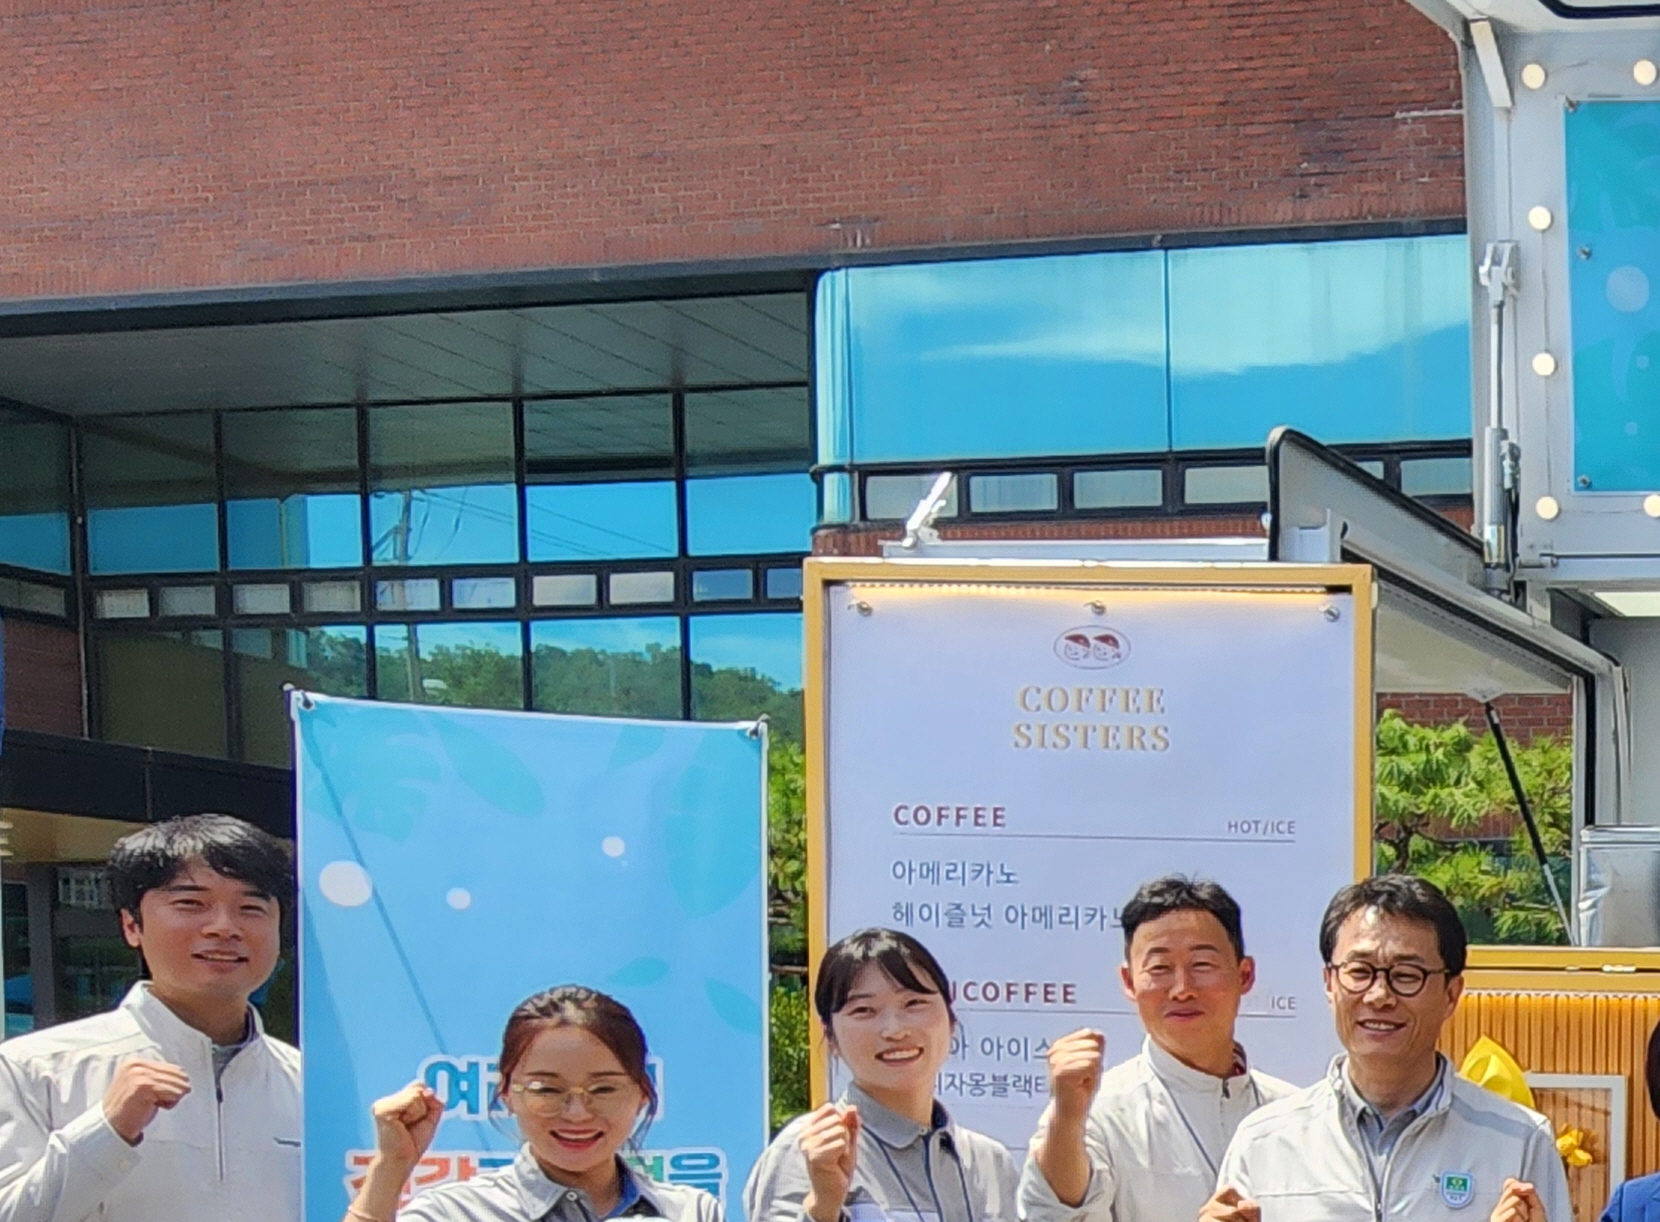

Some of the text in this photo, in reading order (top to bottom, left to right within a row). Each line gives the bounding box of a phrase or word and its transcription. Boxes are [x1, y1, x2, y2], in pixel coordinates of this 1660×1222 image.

[1017, 685, 1166, 714] COFFEE
[1013, 722, 1171, 751] SISTERS
[893, 804, 1297, 835] COFFEE HOT/ICE
[891, 859, 1020, 887] 아메리카노
[891, 901, 993, 929] 헤이즐넛
[1271, 996, 1297, 1010] ICE
